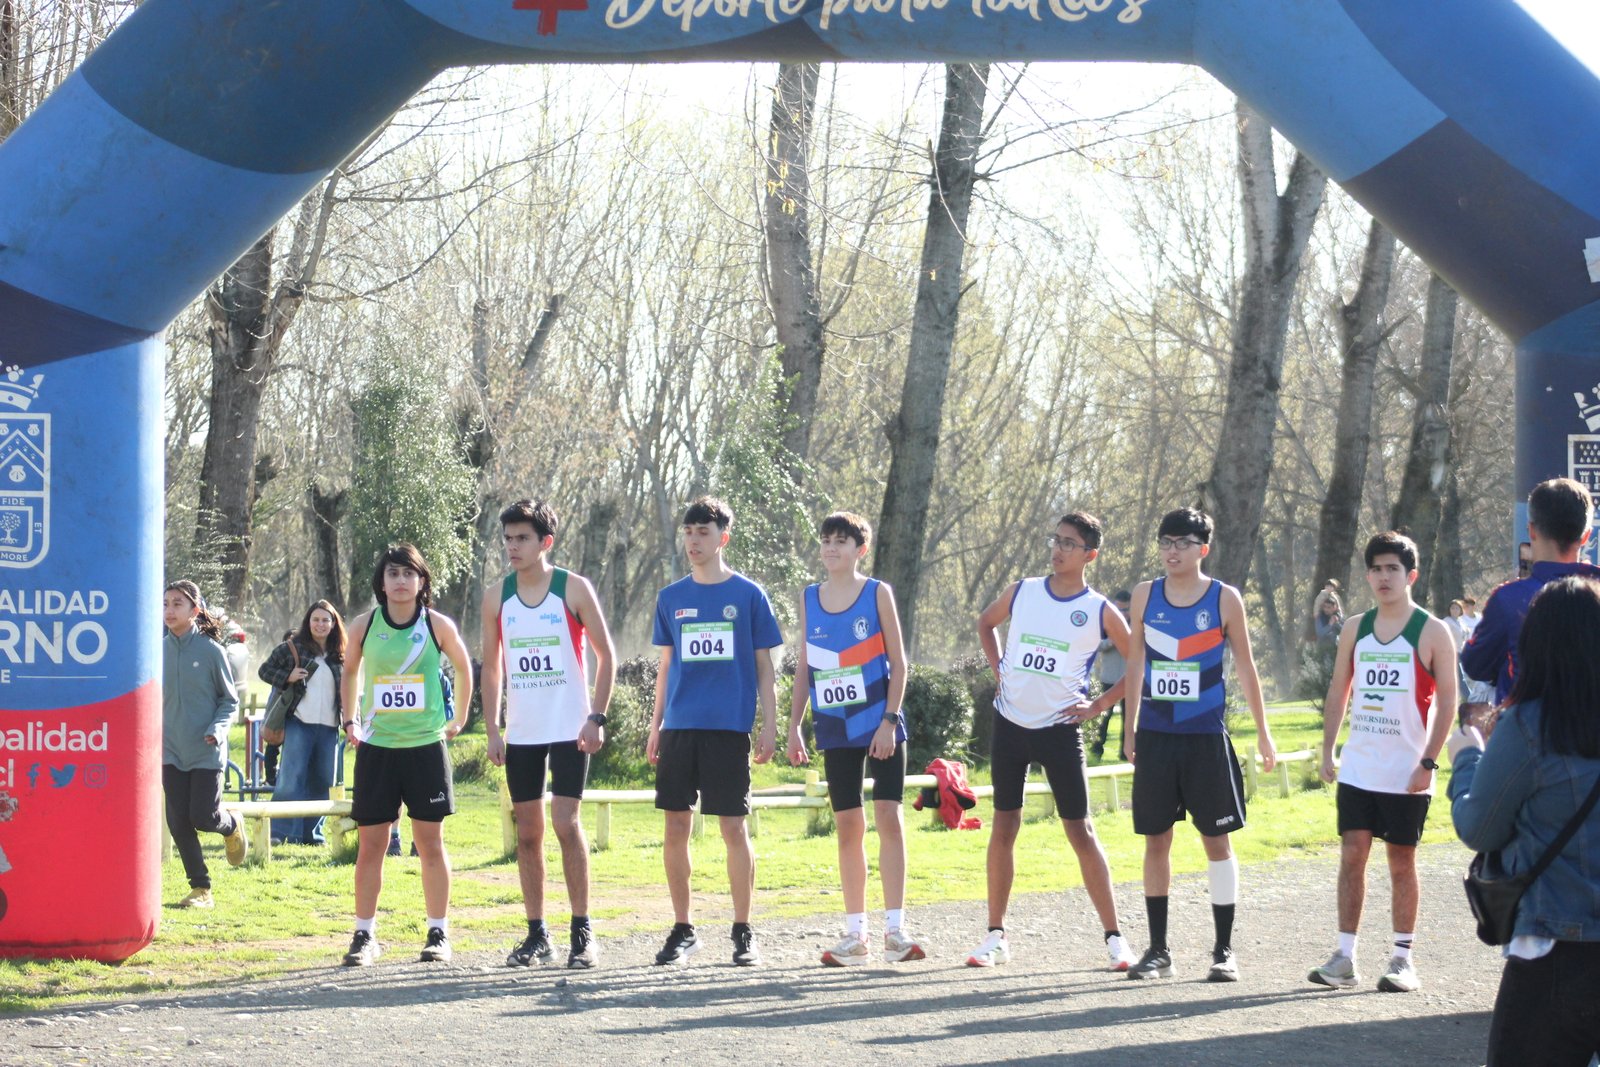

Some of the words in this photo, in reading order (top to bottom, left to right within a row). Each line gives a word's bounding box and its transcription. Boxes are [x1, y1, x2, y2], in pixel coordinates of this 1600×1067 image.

[3, 498, 25, 506] FIDE
[34, 522, 42, 534] ET
[689, 638, 725, 656] 004
[518, 654, 553, 673] 001
[1022, 652, 1057, 673] 003
[522, 681, 538, 689] LOS
[539, 678, 567, 688] LAGOS
[1366, 669, 1400, 686] 002
[823, 684, 858, 704] 006
[1157, 678, 1190, 696] 005
[381, 691, 417, 708] 050
[0, 721, 108, 752] alidad
[1371, 726, 1401, 736] LAGOS
